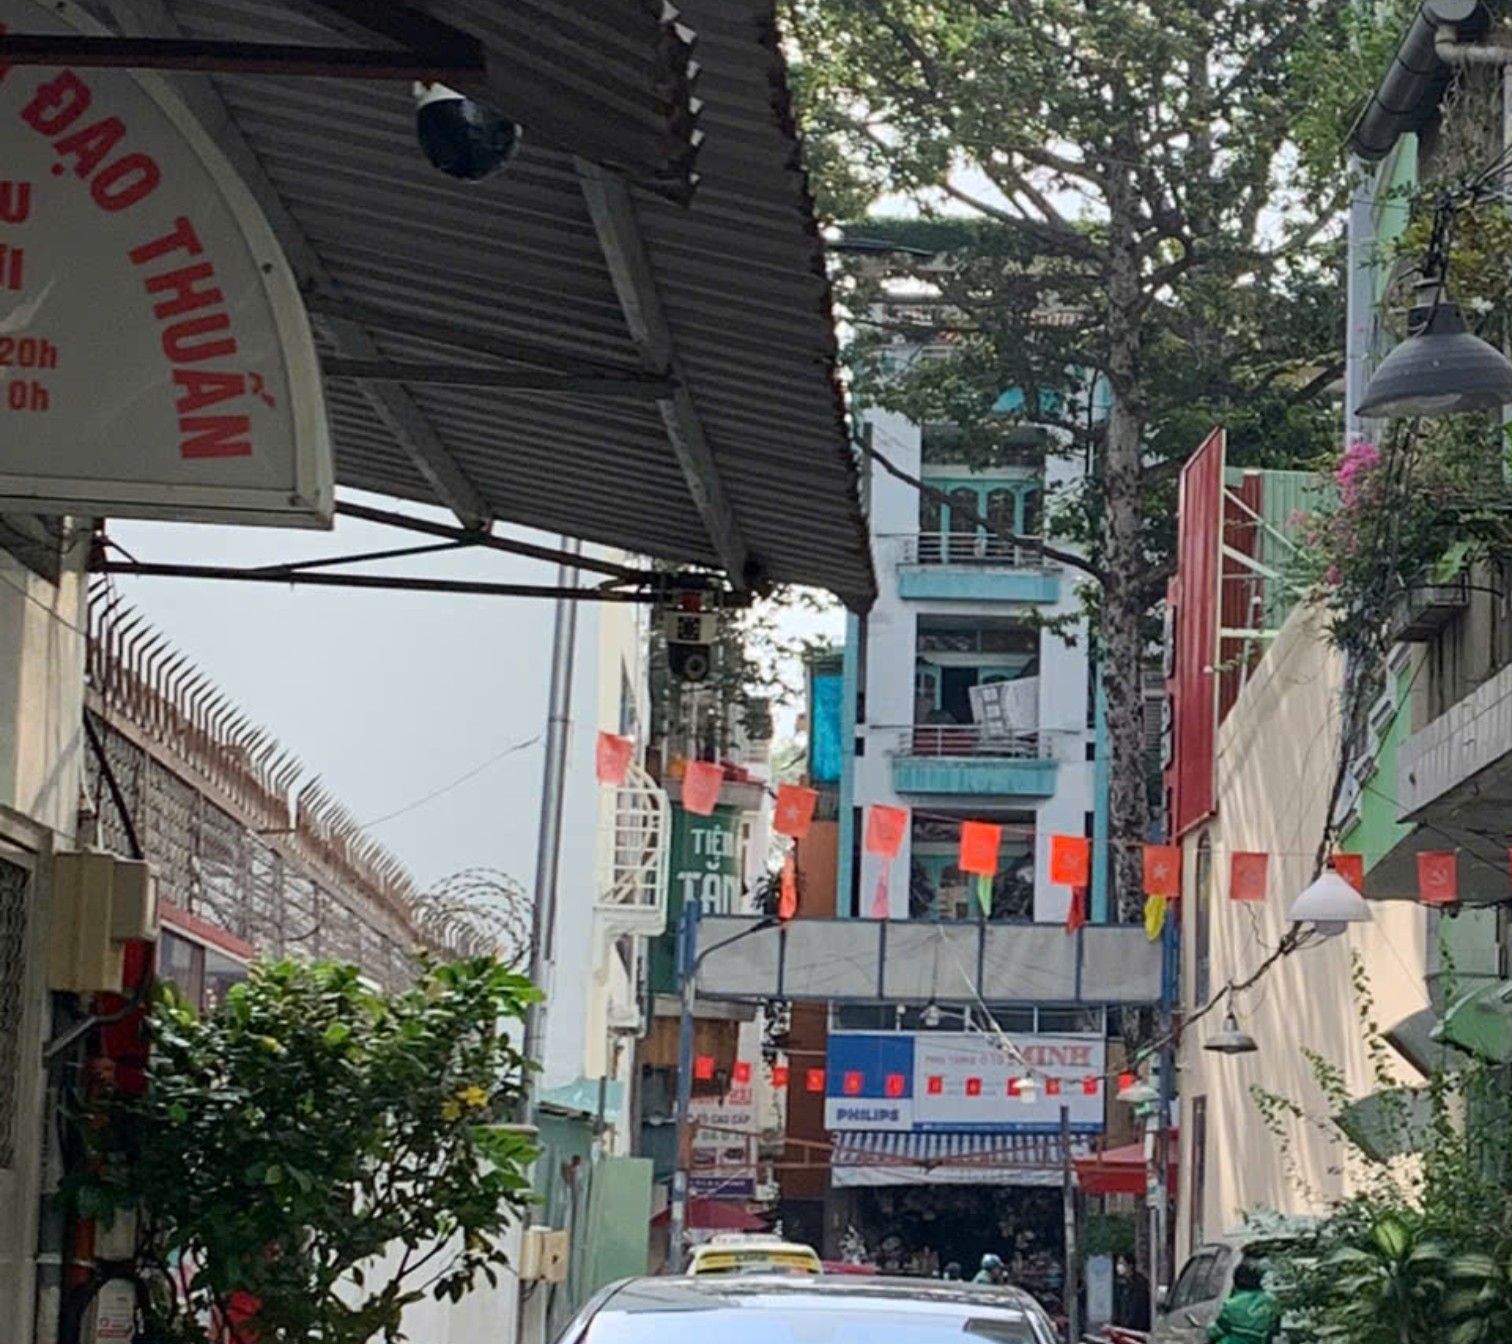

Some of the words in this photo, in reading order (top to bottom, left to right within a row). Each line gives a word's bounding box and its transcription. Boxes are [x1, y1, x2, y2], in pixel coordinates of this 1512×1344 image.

[20, 67, 162, 213] ĐẠO
[128, 214, 276, 462] THUẤN
[836, 1107, 899, 1122] PHILIPS
